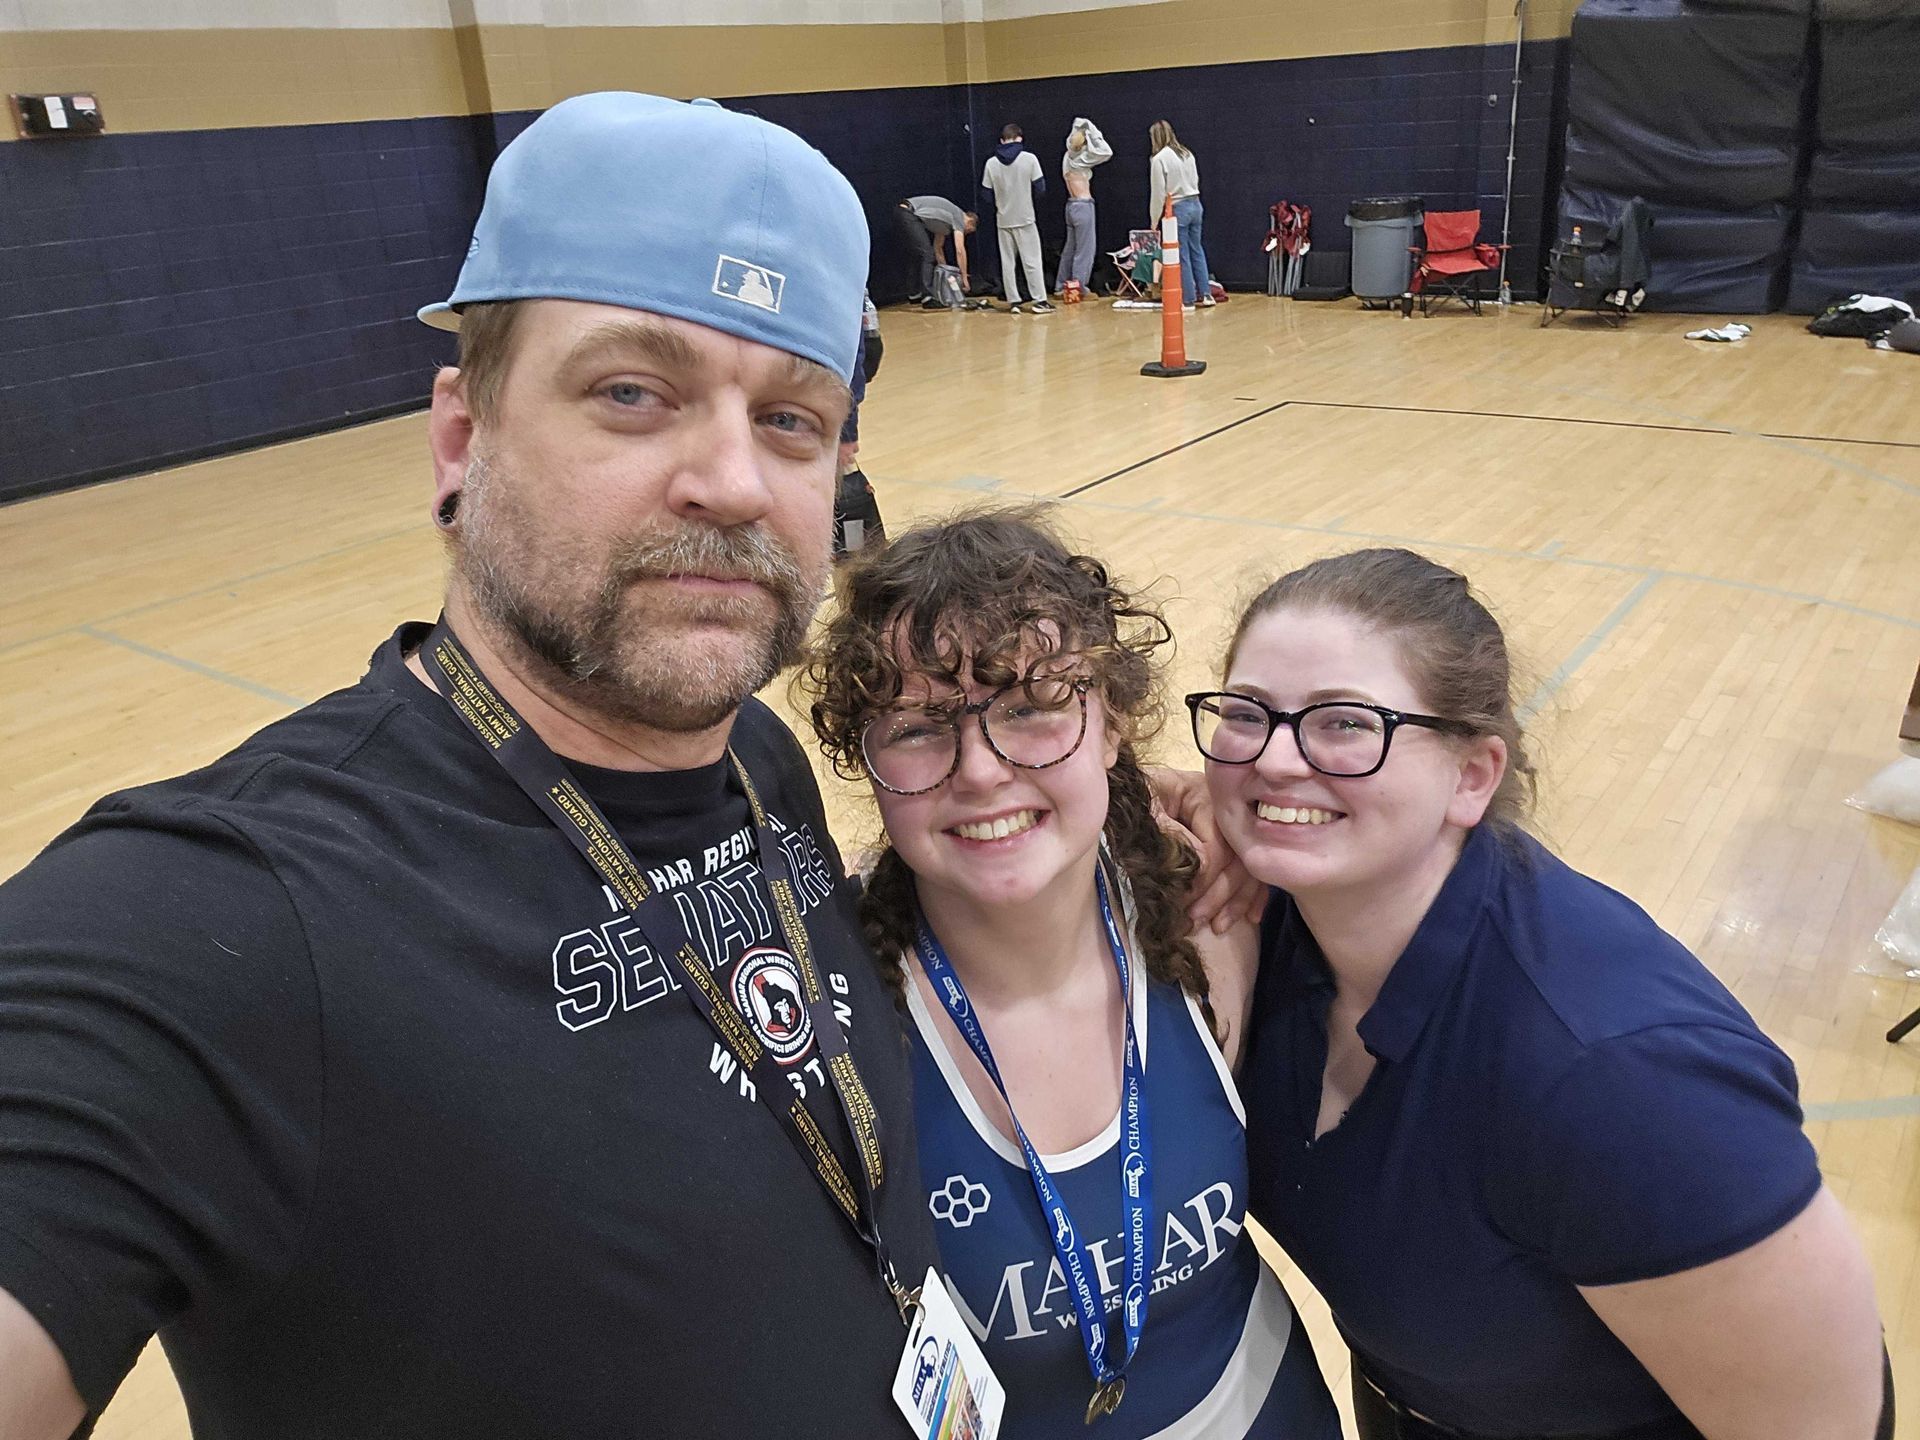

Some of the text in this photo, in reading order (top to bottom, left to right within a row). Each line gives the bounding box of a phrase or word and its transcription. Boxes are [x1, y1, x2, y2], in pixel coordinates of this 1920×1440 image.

[450, 691, 502, 749] MASSACHUSETTS
[456, 672, 490, 715] NATIONAL
[476, 681, 520, 732] 1-800-GO-GUARD
[485, 714, 512, 739] ARMY
[557, 794, 646, 902] ARMY NATIONAL GUARD
[561, 778, 651, 896] 1-800-GO-GUARD nationalguard.com
[586, 846, 638, 911] MASSACHUSETTS
[602, 858, 694, 912] HAR
[776, 880, 818, 993] ARMY NATIONAL GUARD
[918, 929, 943, 971] MPION
[684, 958, 759, 1062] ARMY NATIONAL GUARD
[738, 955, 801, 1018] MAHAR REGIONAL WRESTL
[710, 1009, 755, 1071] MASSACHUSETTS
[836, 1056, 881, 1176] ARMY NATIONAL GUARD
[843, 1052, 876, 1120] MASSACHUSETTS
[1128, 1077, 1141, 1150] CHAMPION
[796, 1113, 816, 1145] GUARD
[815, 1144, 842, 1188] NATIONAL
[1133, 1207, 1144, 1280] CHAMPION
[1067, 1251, 1096, 1320] CHAMPION
[913, 1367, 927, 1402] MIAA
